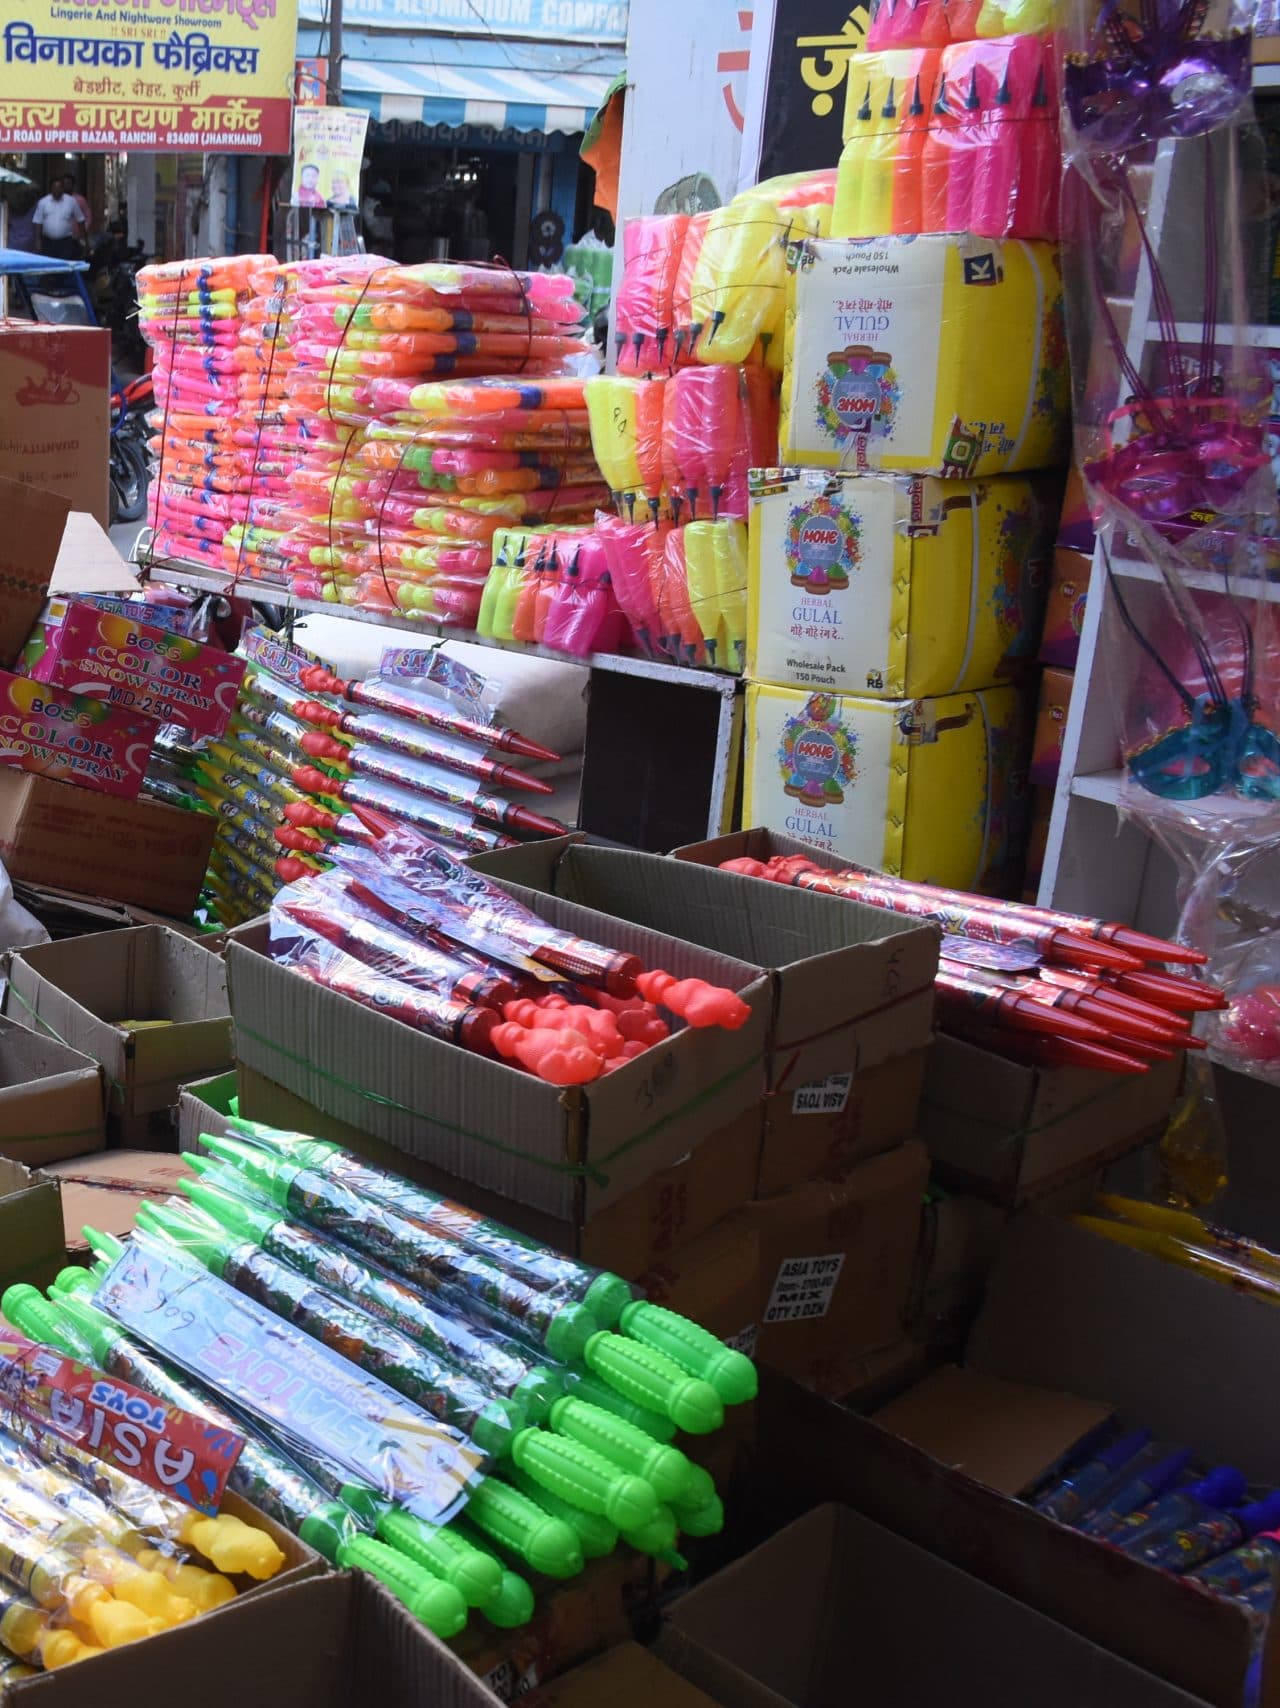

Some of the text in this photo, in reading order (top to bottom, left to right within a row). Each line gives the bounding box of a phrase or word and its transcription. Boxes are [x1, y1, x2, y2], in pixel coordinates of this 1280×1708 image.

[50, 6, 223, 28] Lingerie And Nightware Showroom
[3, 21, 260, 76] विनायका फैब्रिक्स
[73, 103, 183, 131] नारायण
[191, 98, 262, 131] मार्केट
[13, 131, 44, 143] ROAD
[45, 131, 80, 144] UPPER
[81, 132, 118, 145] BAZAR,
[120, 133, 157, 145] RANCHI
[201, 133, 263, 147] (JHARKHAND)
[833, 264, 900, 275] Wholesale Pack
[834, 315, 890, 331] GULAL
[843, 333, 880, 342] HERBAL
[96, 599, 154, 620] ASIA TOYS
[800, 597, 833, 608] HERBAL
[792, 606, 842, 624] GULAL
[126, 631, 182, 661] BOSS
[96, 645, 202, 691] COLOR
[786, 657, 846, 673] Wholesale Pack
[79, 658, 216, 711] SNOW SPRAY
[810, 674, 836, 685] Pouch
[107, 685, 173, 719] MD-250
[30, 697, 93, 729] BOSS
[54, 752, 128, 783] SPRAY
[785, 816, 838, 838] GULAL
[797, 1091, 846, 1108] ASIA TOYS
[781, 1258, 840, 1277] ASIA TOYS
[778, 1290, 823, 1302] MIX
[768, 1305, 793, 1321] QTY
[88, 1381, 169, 1434] TOYS
[50, 1388, 197, 1486] ASIA
